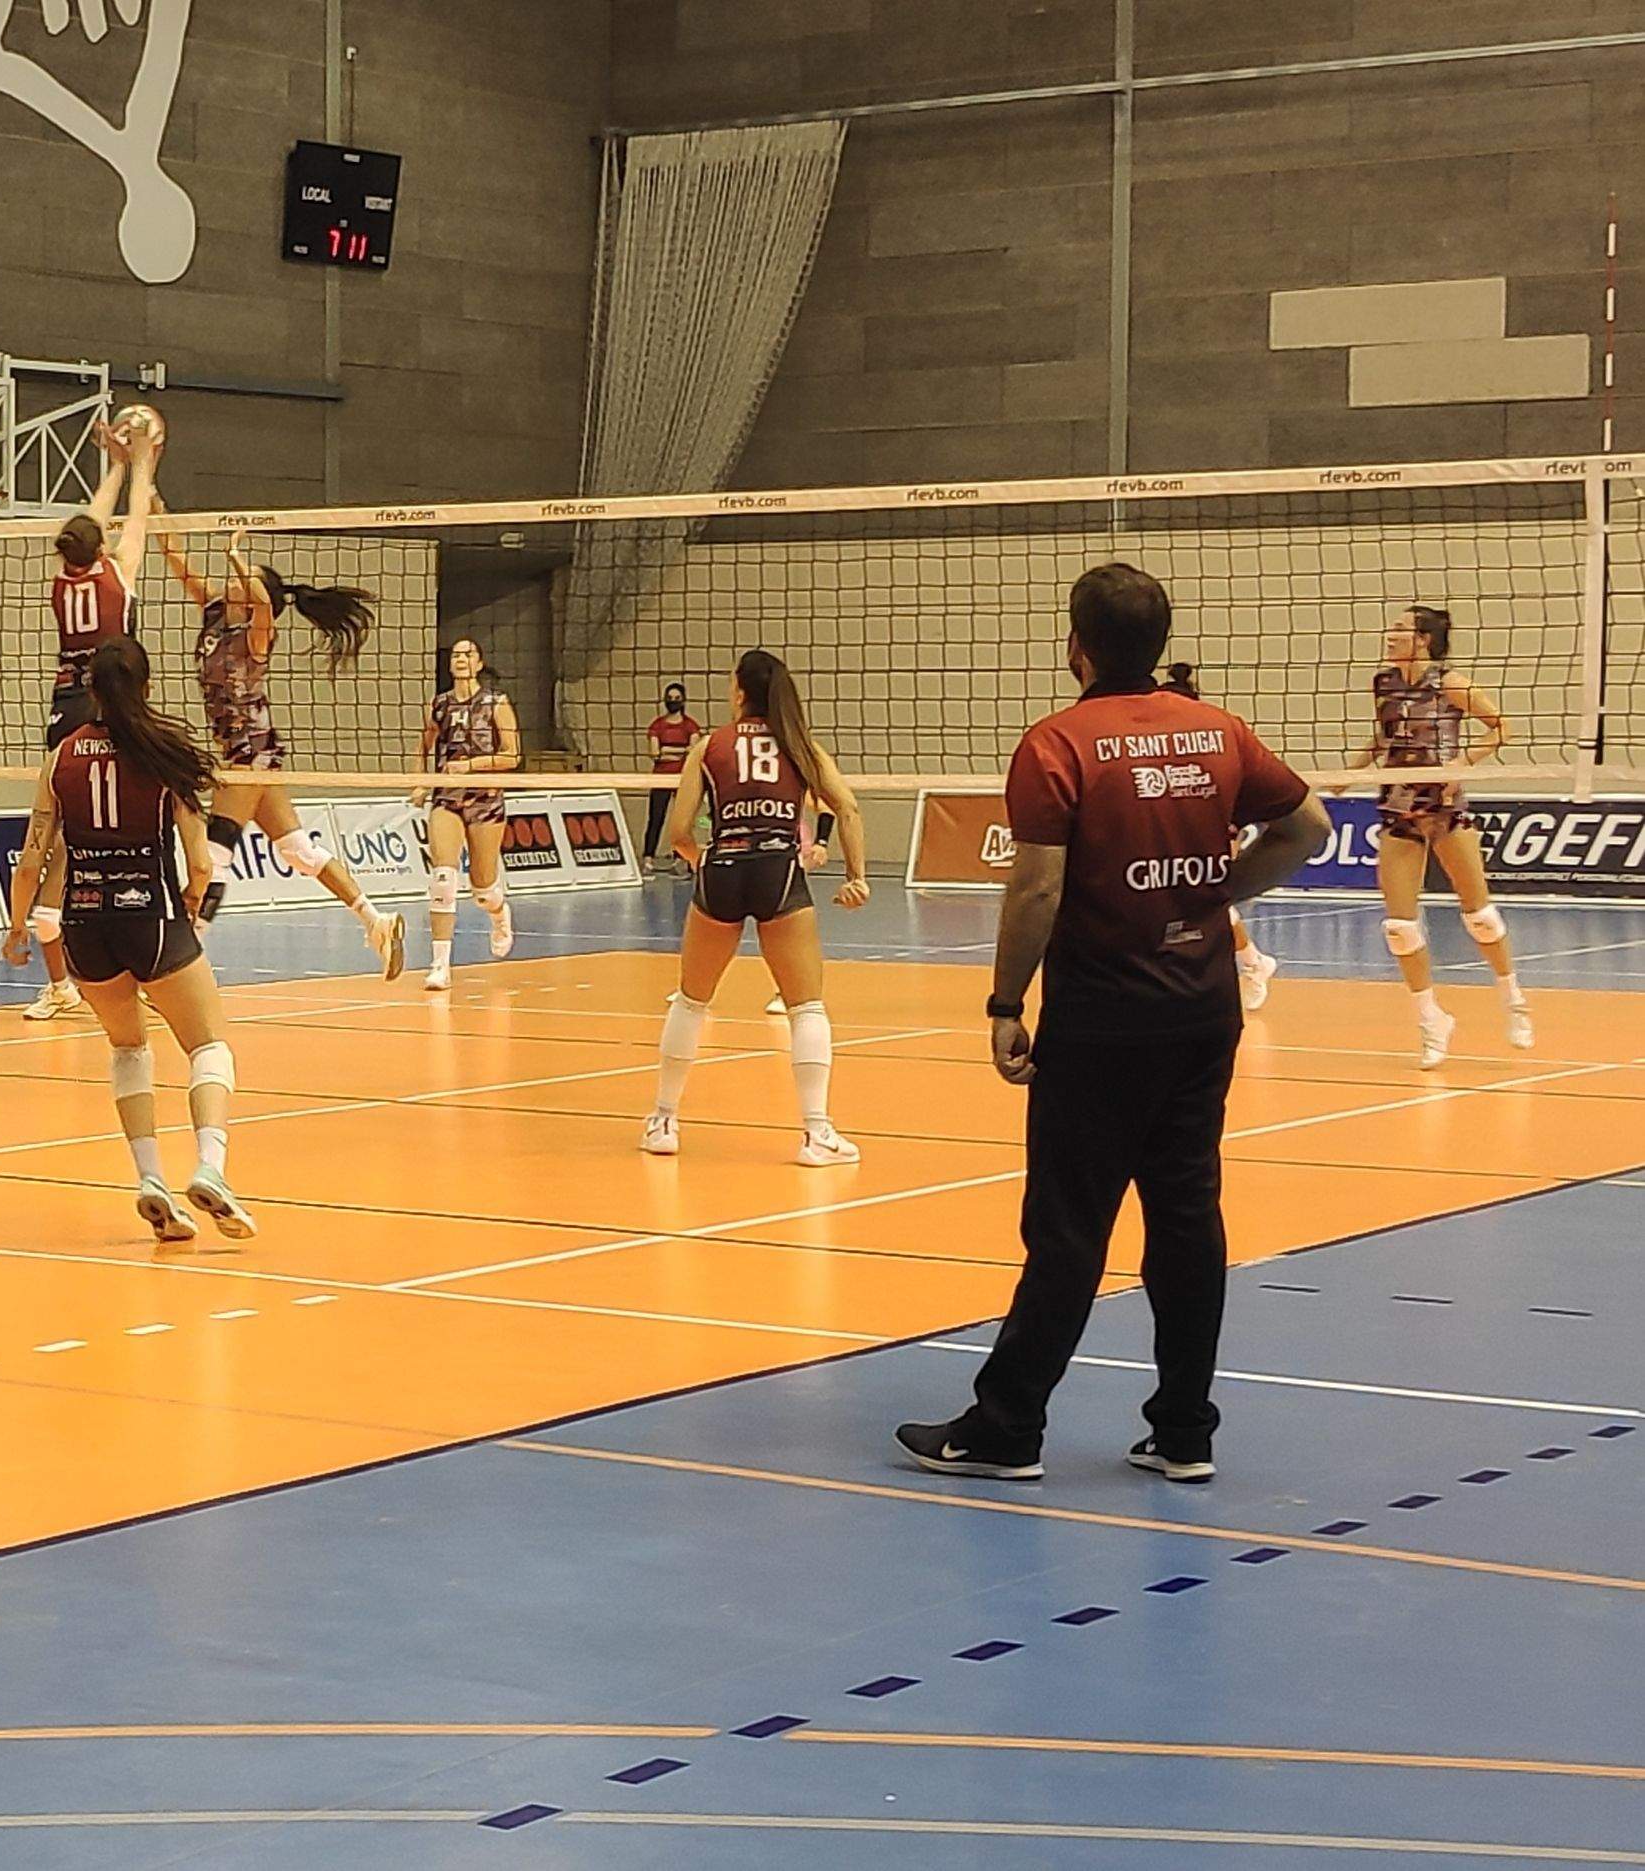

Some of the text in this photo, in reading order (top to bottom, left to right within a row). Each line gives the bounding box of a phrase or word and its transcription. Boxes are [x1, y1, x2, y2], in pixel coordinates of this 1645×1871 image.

[301, 186, 332, 203] LOCAL
[330, 229, 368, 260] 7 11
[1319, 470, 1401, 484] rfevb.com
[907, 488, 979, 501] rfevb.com
[1106, 479, 1184, 493] rfevb.com
[541, 503, 605, 516] rfevb.com
[718, 496, 787, 509] rfevb.com
[375, 509, 436, 521] rfevb.com
[62, 582, 98, 635] 10
[1096, 730, 1225, 762] CV SANT CUGAT
[734, 736, 779, 784] 18
[88, 760, 119, 828] 11
[1126, 854, 1231, 891] GRIFOLS
